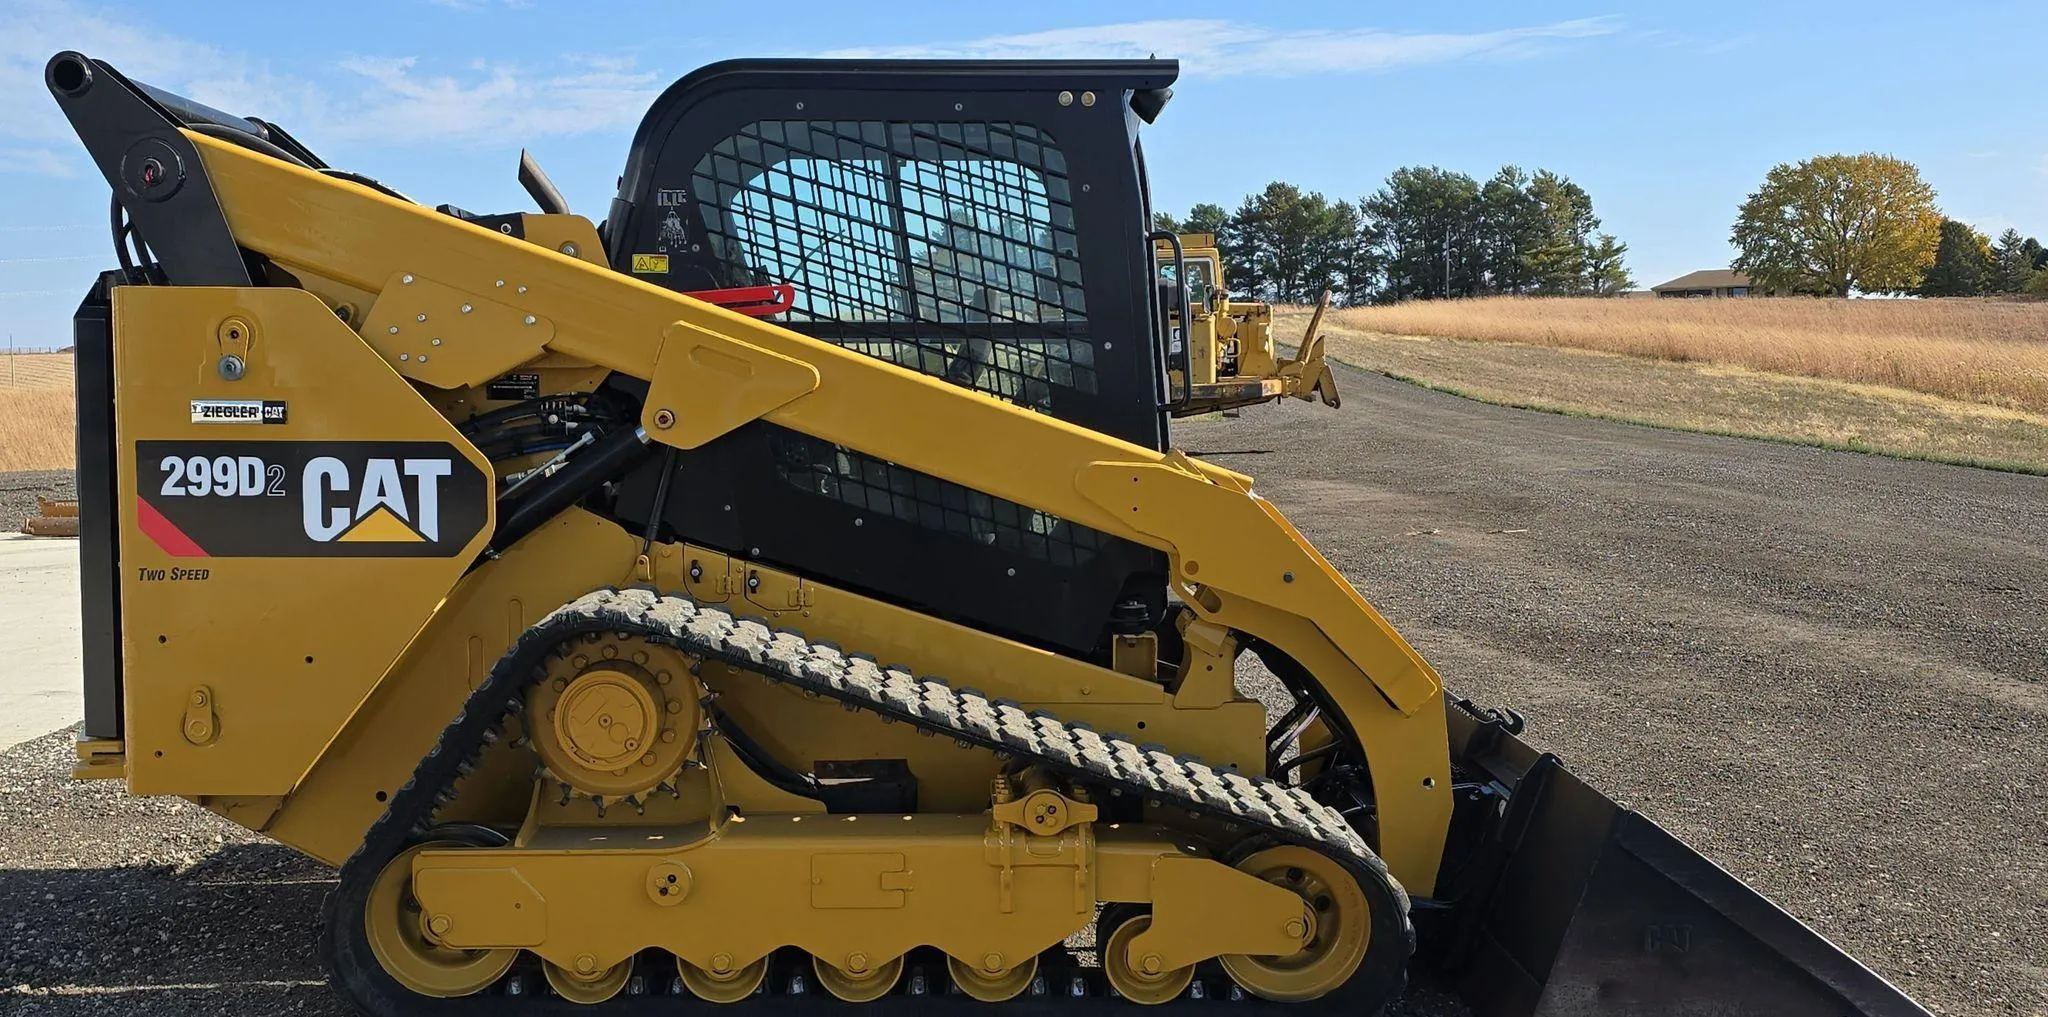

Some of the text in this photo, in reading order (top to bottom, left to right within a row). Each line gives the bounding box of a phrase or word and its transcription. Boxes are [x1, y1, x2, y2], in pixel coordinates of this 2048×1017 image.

[203, 406, 284, 418] ZIEGLER CAT
[160, 455, 452, 542] 299D2 CAT
